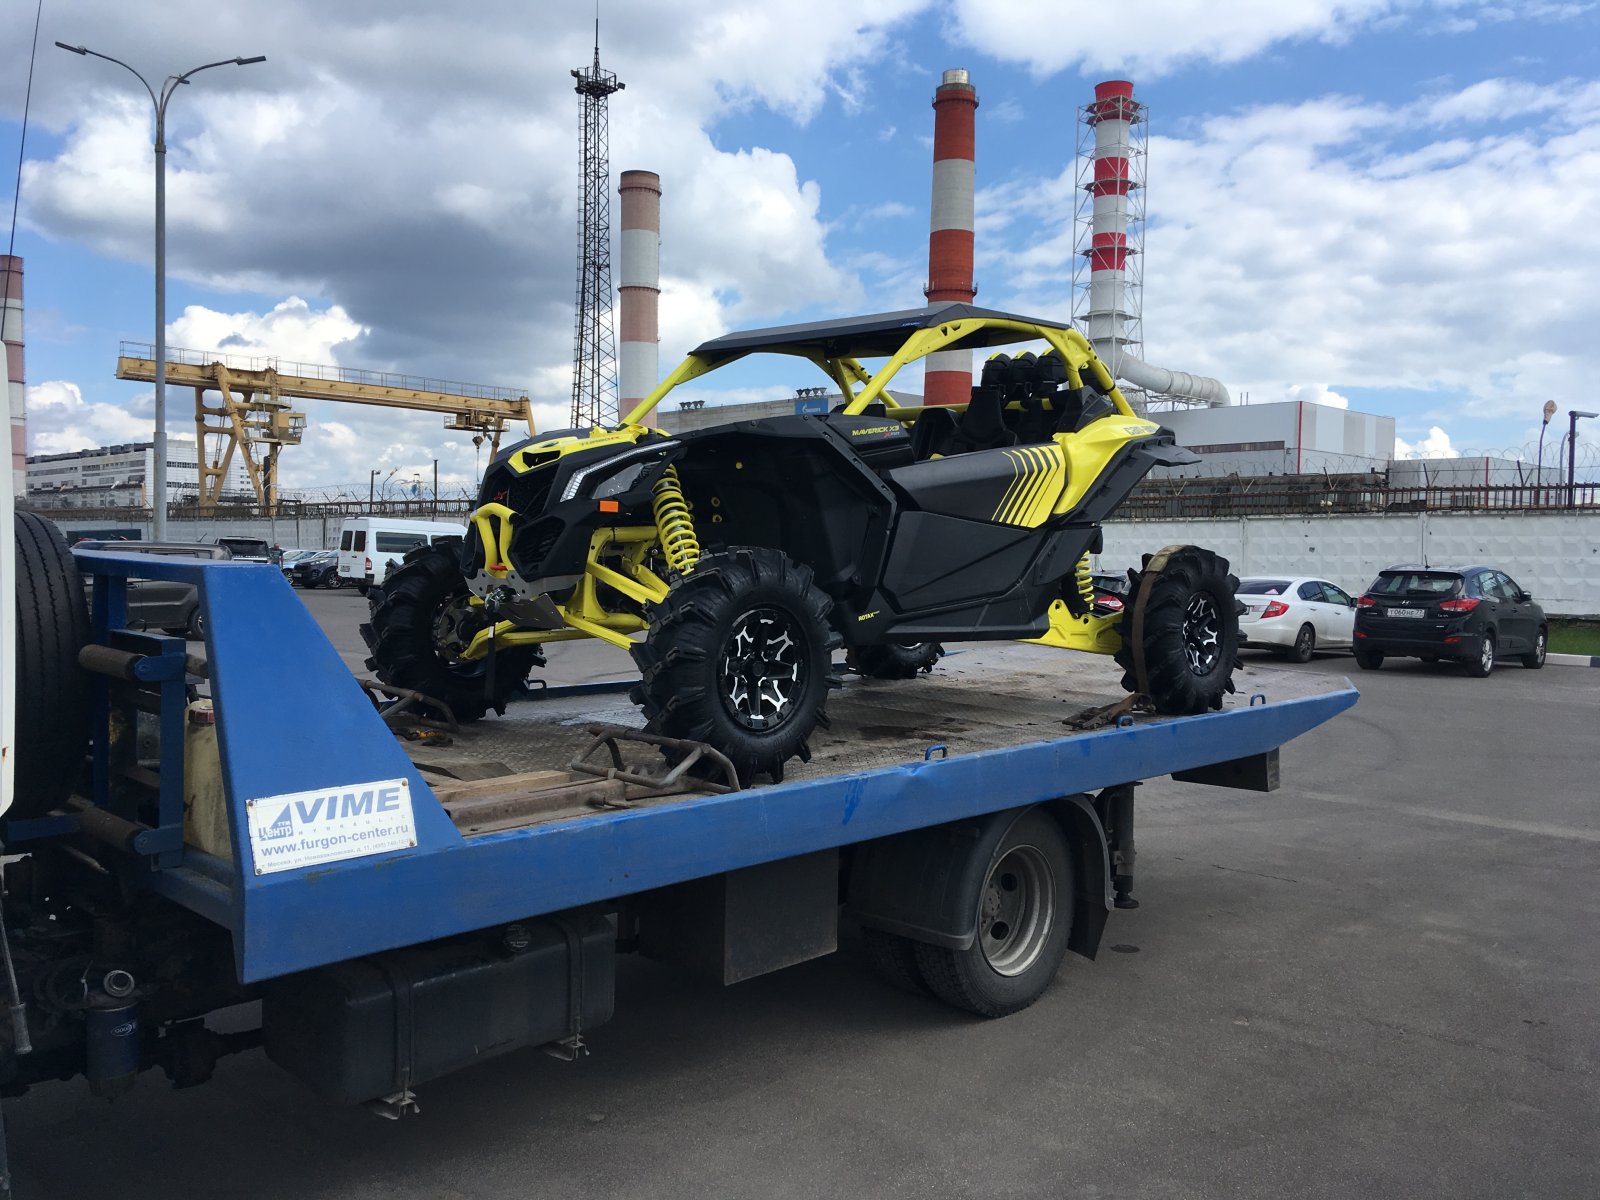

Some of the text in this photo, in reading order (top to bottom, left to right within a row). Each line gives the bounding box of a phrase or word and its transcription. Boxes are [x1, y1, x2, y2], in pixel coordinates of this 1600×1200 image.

[852, 426, 888, 436] MAVERICK
[858, 612, 874, 621] ROTAX
[294, 787, 400, 824] VIME
[261, 824, 409, 857] www.furgon-center.ru
